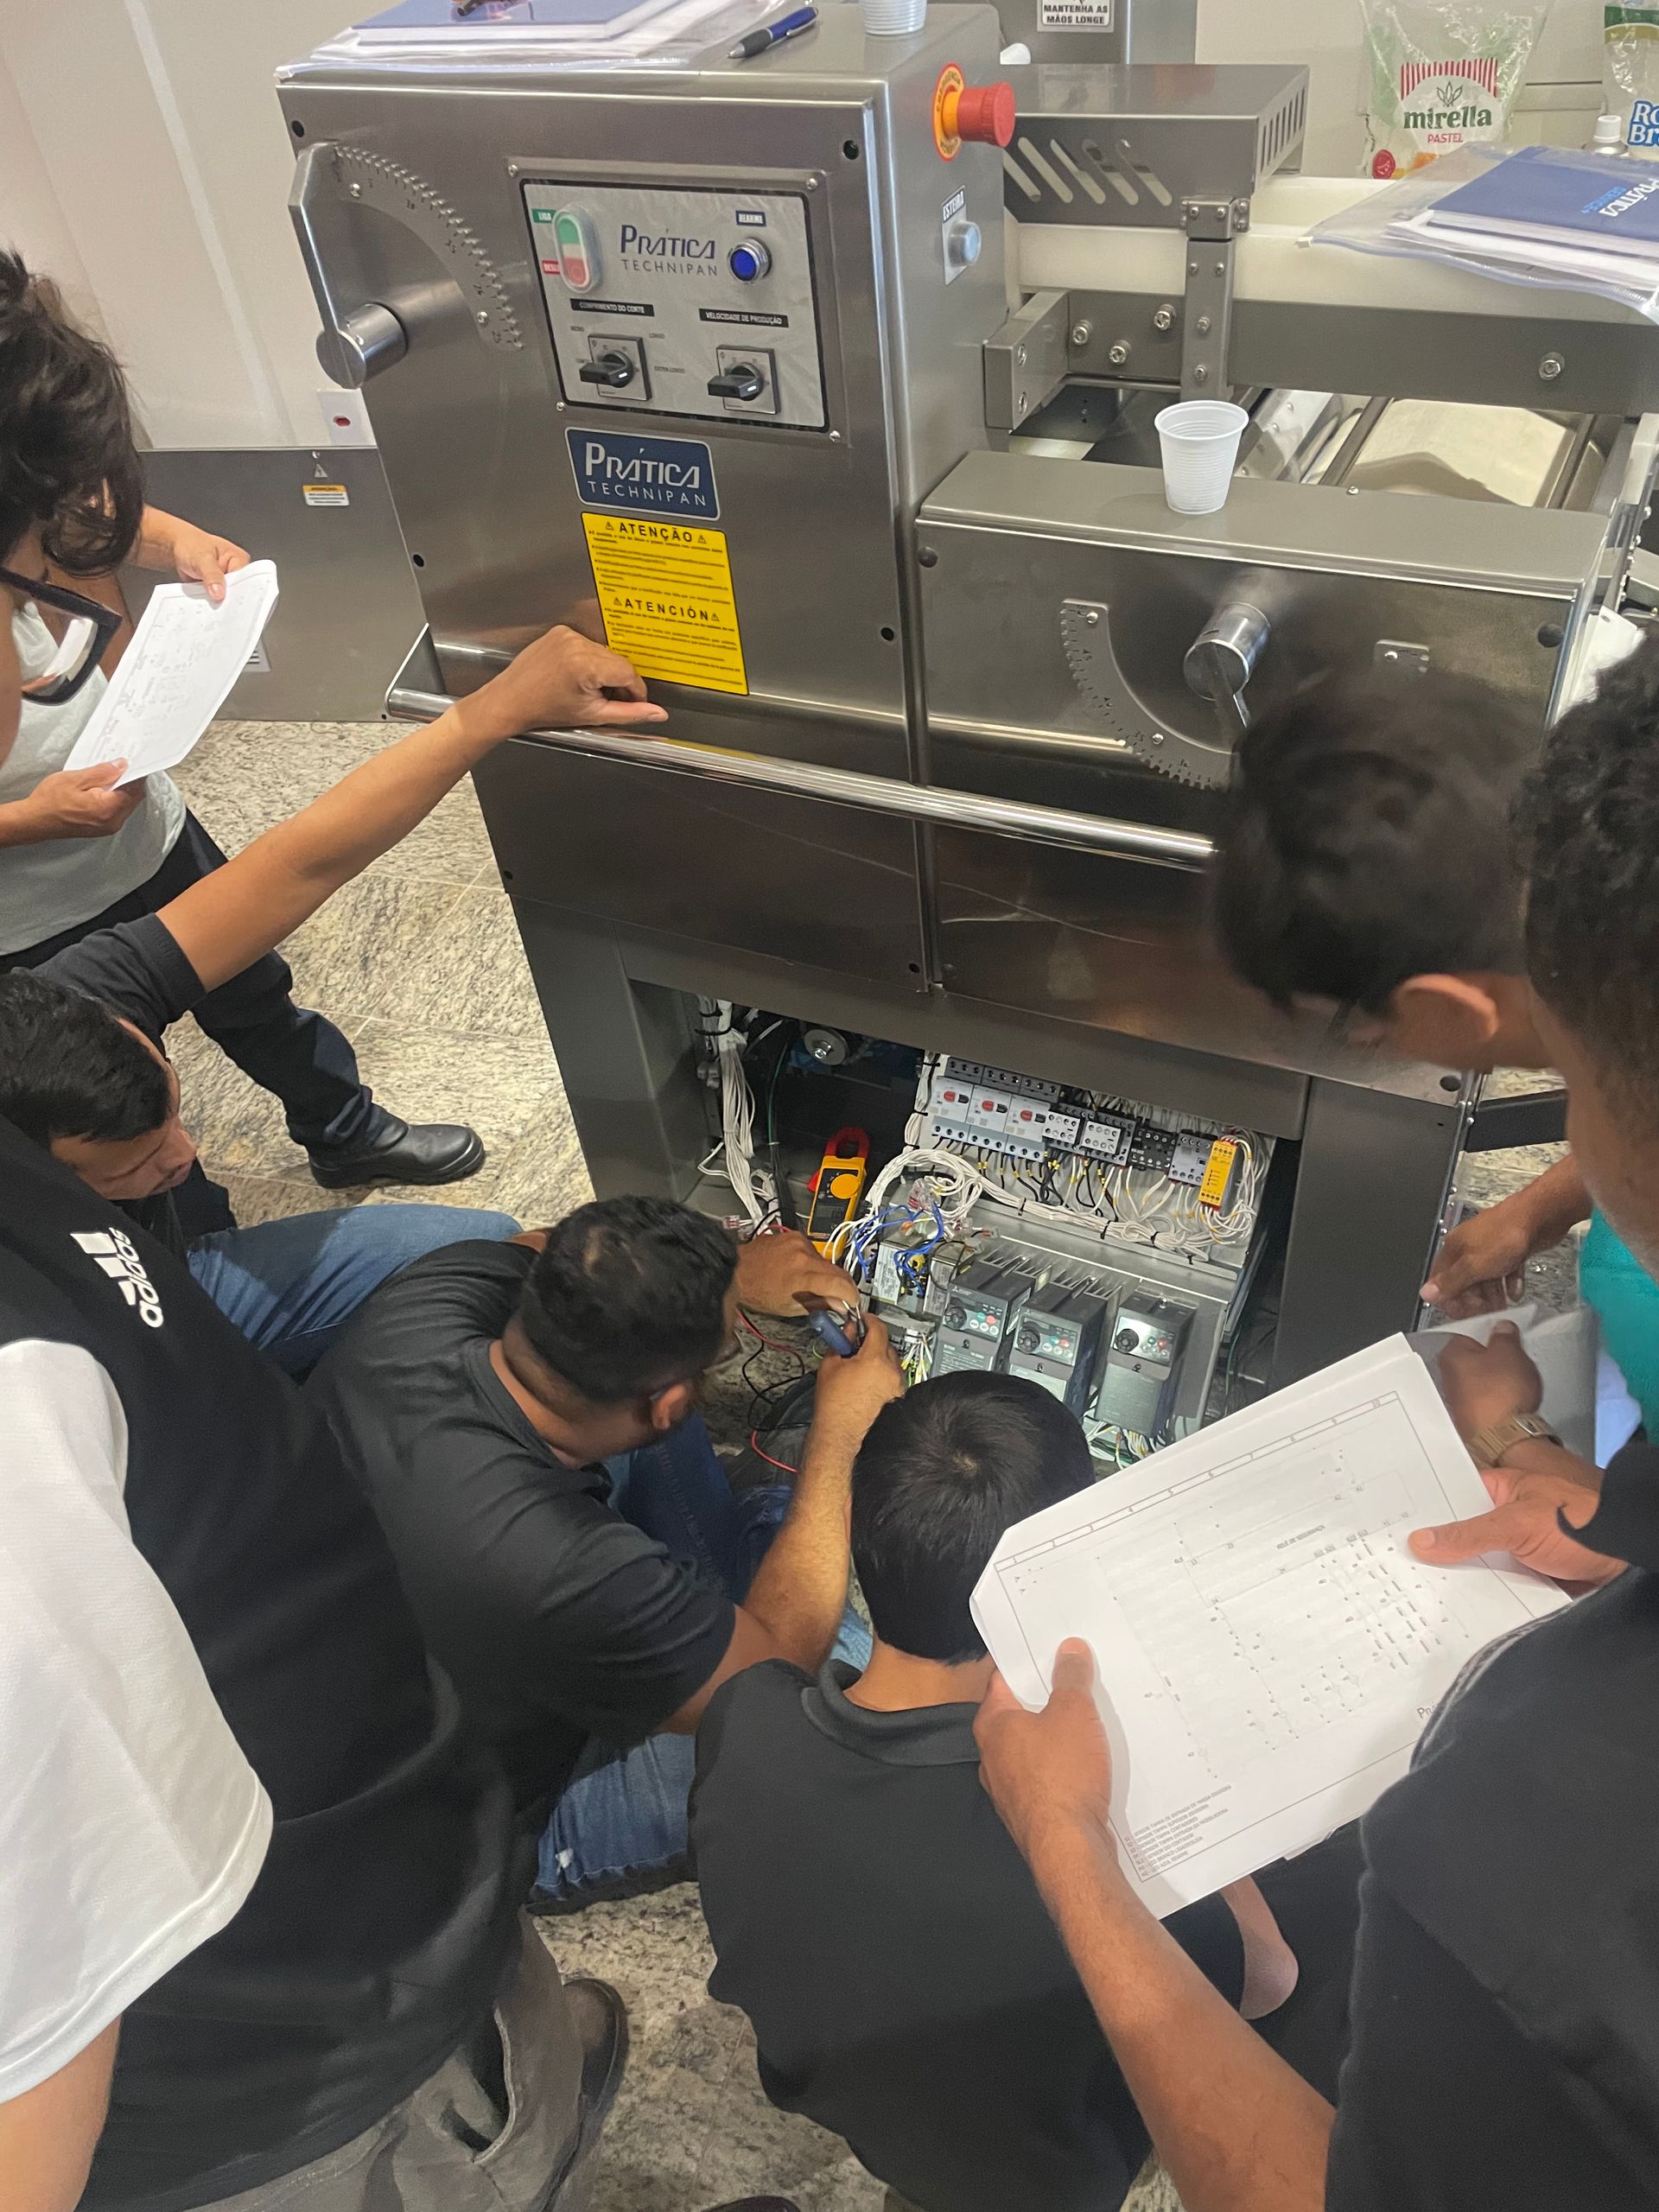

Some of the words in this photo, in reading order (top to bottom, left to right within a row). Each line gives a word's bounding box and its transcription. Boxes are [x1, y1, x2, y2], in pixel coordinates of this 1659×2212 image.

[1043, 4, 1093, 13] MANTENHA
[1046, 14, 1074, 23] MÃOS
[1075, 16, 1104, 24] LONGE
[1403, 105, 1492, 130] mirella
[1427, 133, 1464, 143] PASTEL
[621, 225, 715, 259] PRÁTICA
[621, 258, 717, 276] TECHNIPAN
[705, 312, 741, 321] VELOCIDADE
[750, 315, 782, 325] PRODUÇÃO
[585, 442, 700, 489] PRÁTICA
[588, 480, 706, 506] TECHNIPAN
[620, 523, 692, 543] ATENÇÃO
[625, 598, 709, 622] ATENCIÓN
[109, 1227, 163, 1328] adidas
